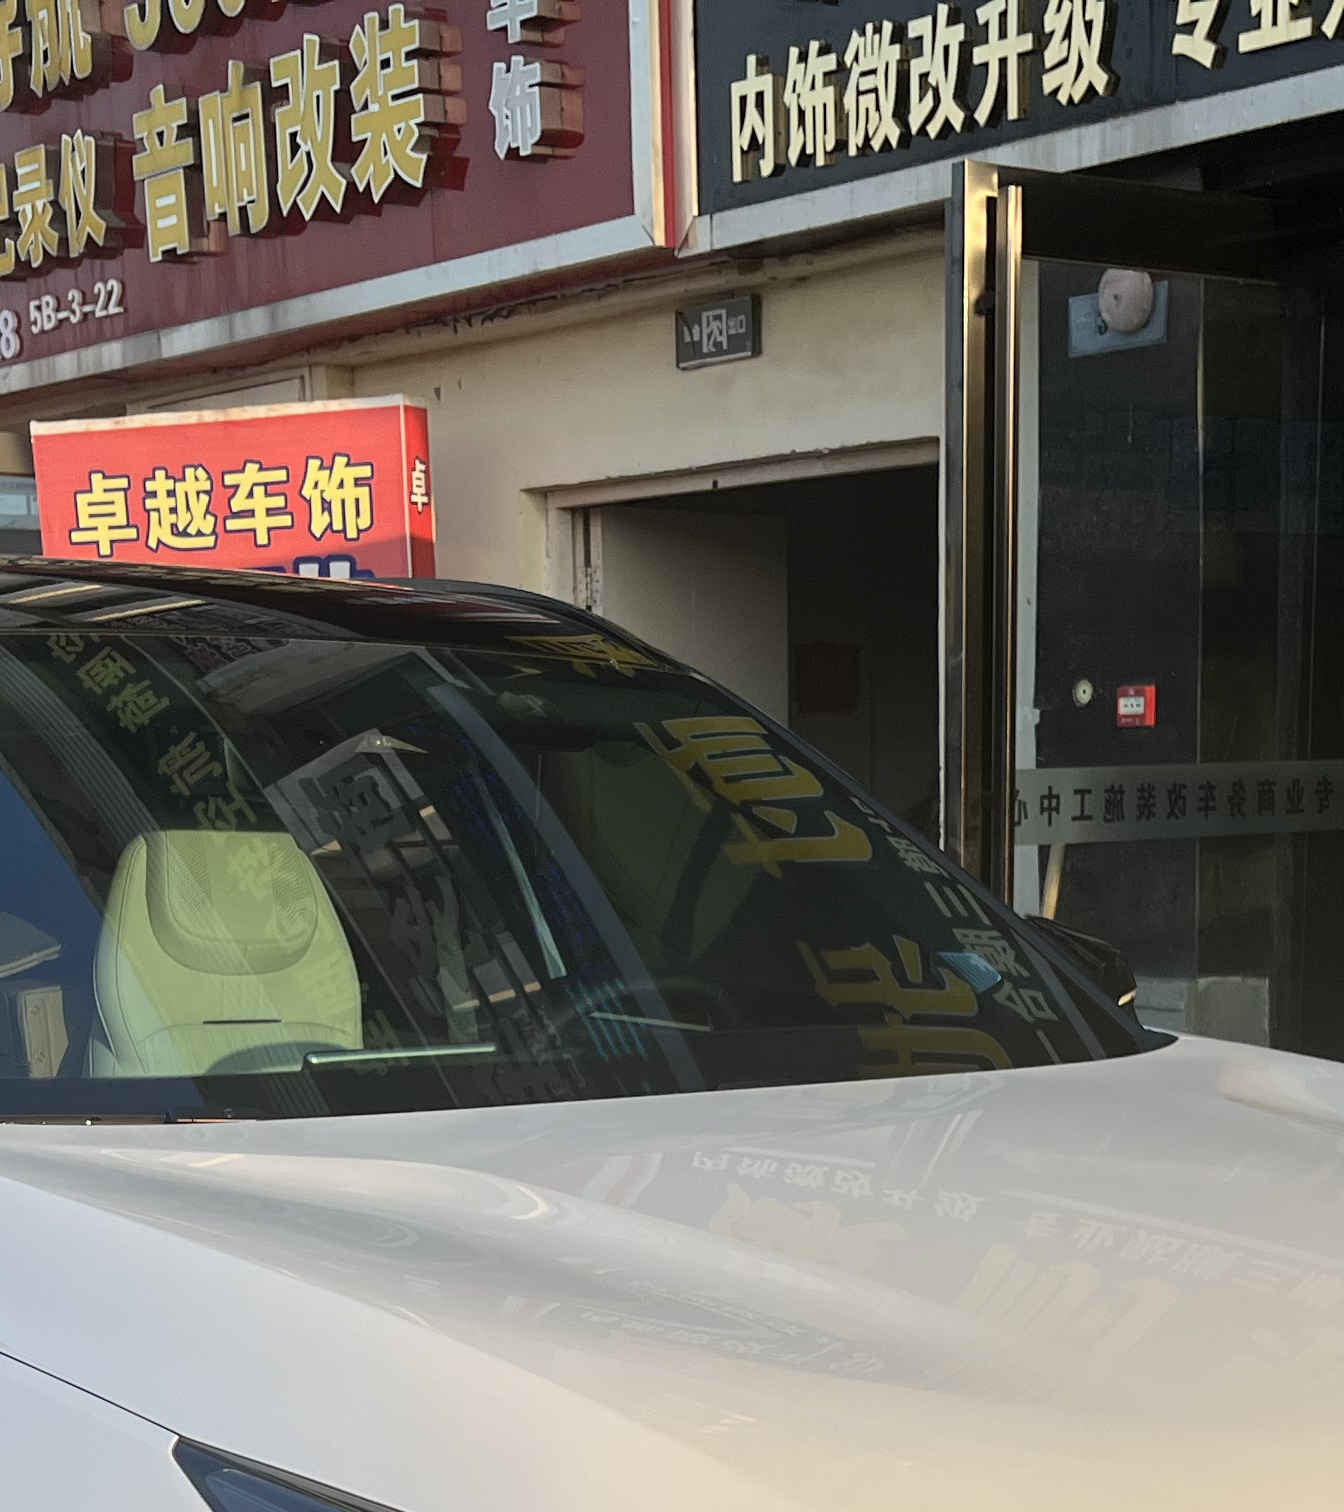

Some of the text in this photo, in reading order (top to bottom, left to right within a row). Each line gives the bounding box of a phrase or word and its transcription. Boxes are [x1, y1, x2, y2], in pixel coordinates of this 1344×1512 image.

[133, 3, 429, 262] 音响改装
[730, 0, 1112, 182] 内饰微改升级
[70, 452, 374, 558] 卓越车饰
[410, 459, 431, 512] 卓
